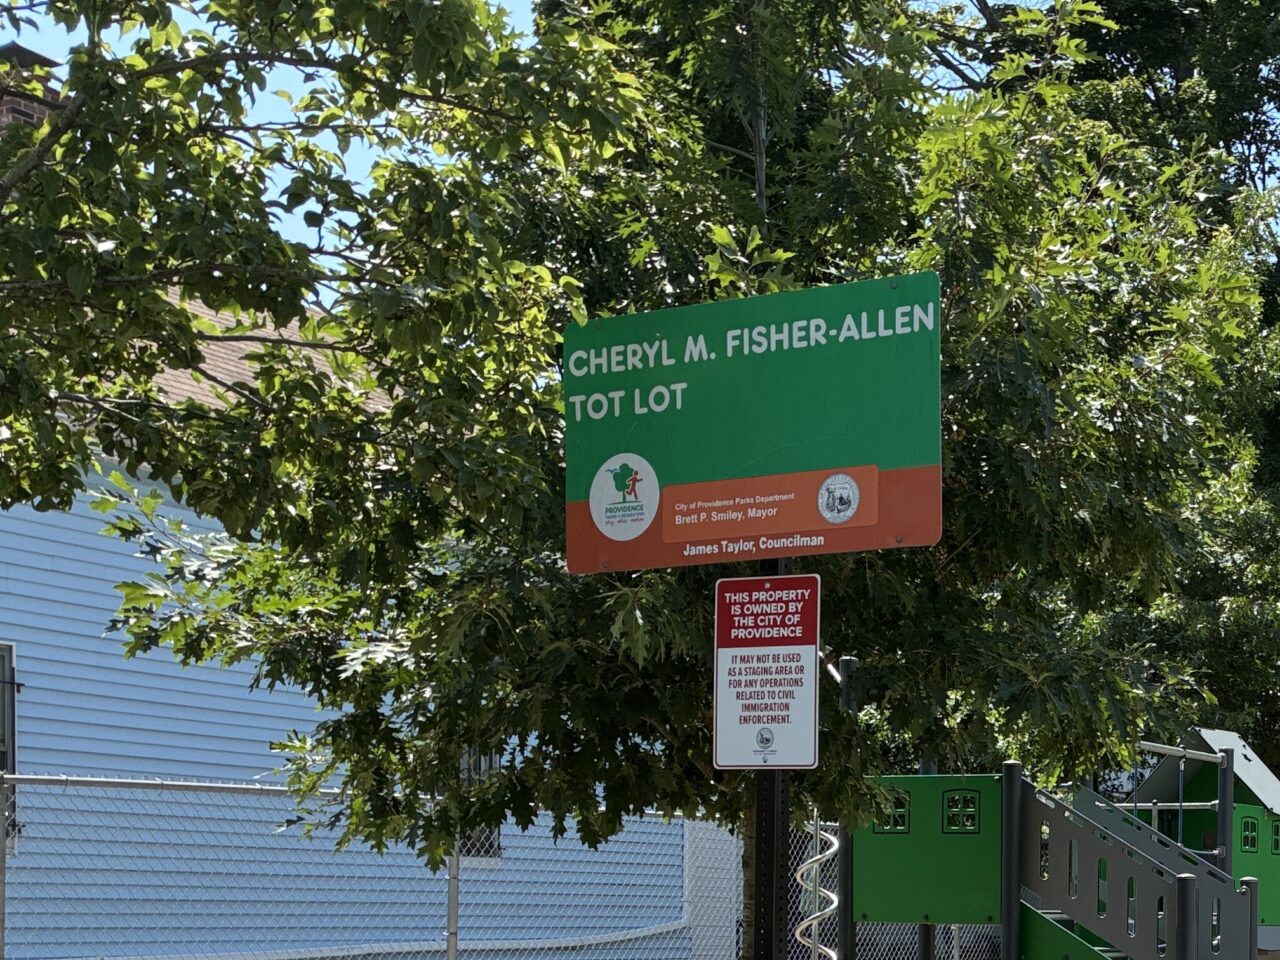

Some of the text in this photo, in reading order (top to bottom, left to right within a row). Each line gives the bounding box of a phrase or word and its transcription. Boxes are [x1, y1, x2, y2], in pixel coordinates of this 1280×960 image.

[568, 302, 934, 377] CHERYL M. FISHER-ALLEN
[568, 382, 688, 422] TOT LOT
[605, 504, 644, 514] PROVIDENCE
[674, 503, 688, 512] City
[689, 502, 697, 510] of
[697, 499, 734, 508] Providence
[755, 493, 795, 503] Department
[675, 507, 778, 525] Brett P. Smiley, Mayor
[683, 534, 824, 556] James Taylor, Councilman
[724, 589, 811, 603] THIS PROPERTY
[731, 601, 804, 615] IS OWNED BY
[733, 614, 801, 627] THE CITY OF
[731, 626, 803, 639] PROVIDENCE
[731, 653, 801, 664] IT MAY NOT BE USED
[728, 665, 805, 677] AS A STAGING AREA OR
[728, 677, 804, 689] FOR ANY OPERATIONS
[736, 690, 796, 701] RELATED TO CIVIL
[741, 702, 790, 713] IMMIGRATION
[739, 714, 793, 725] ENFORCEMENT.
